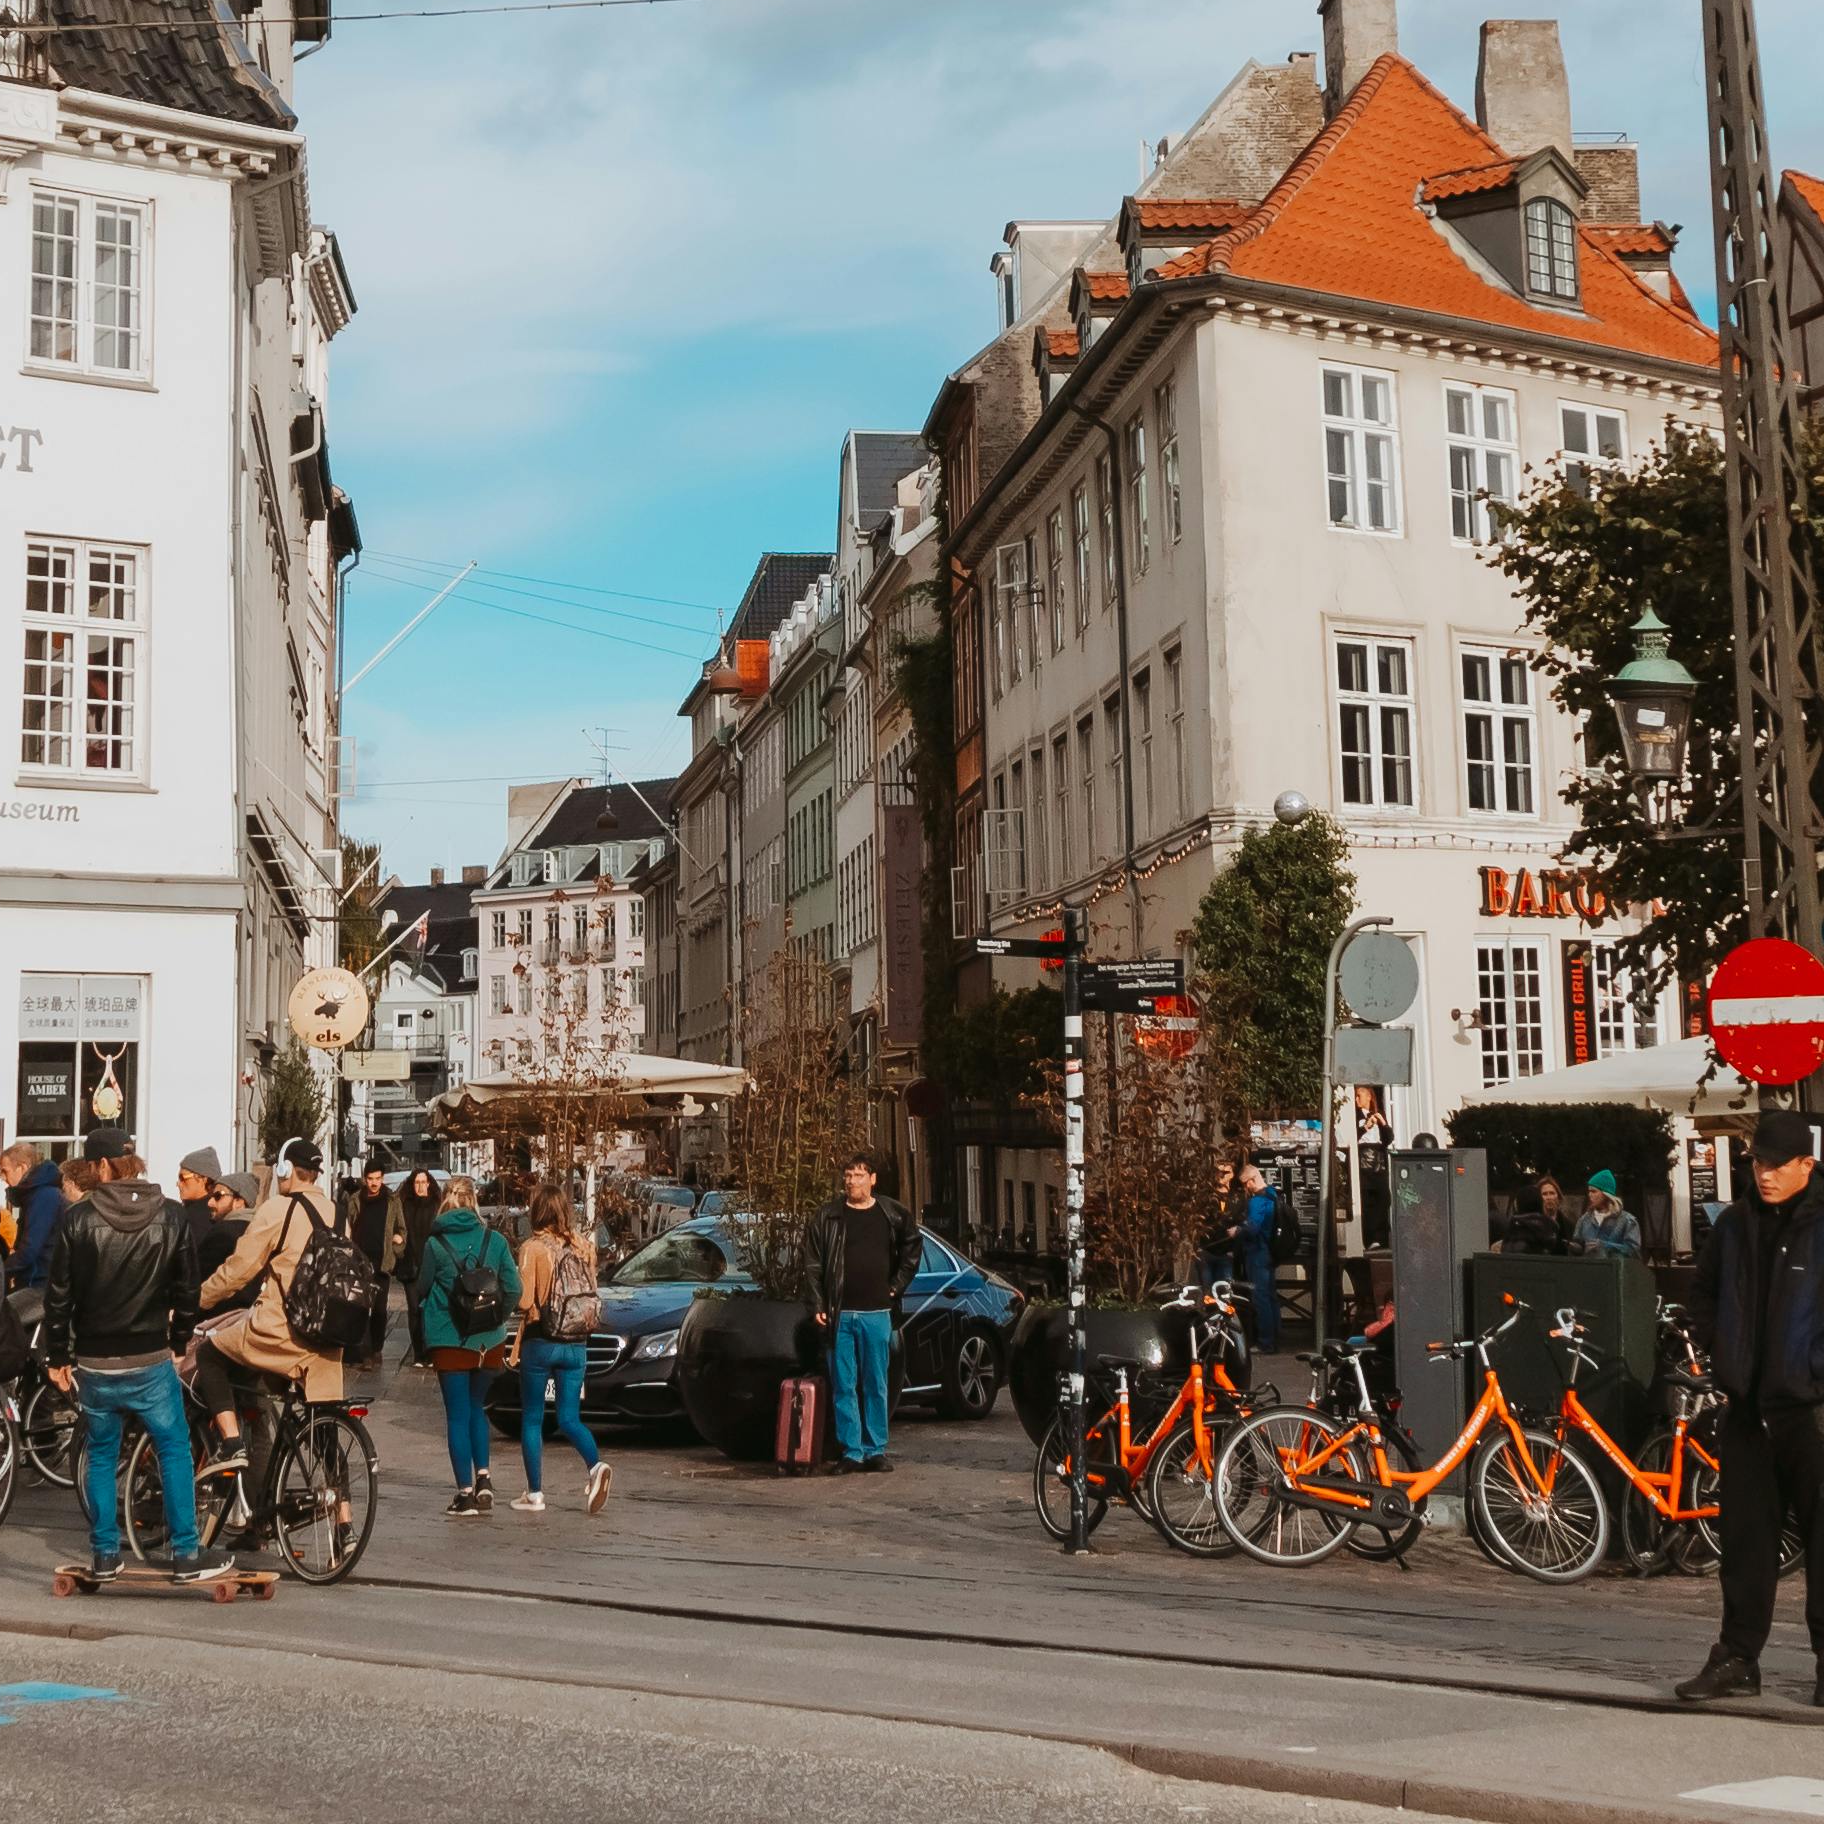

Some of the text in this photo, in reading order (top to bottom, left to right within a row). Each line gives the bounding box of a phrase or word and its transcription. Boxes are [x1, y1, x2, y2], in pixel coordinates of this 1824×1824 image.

[315, 1029, 341, 1043] els
[27, 1075, 68, 1084] HOUSE OF
[27, 1085, 67, 1096] AMBER
